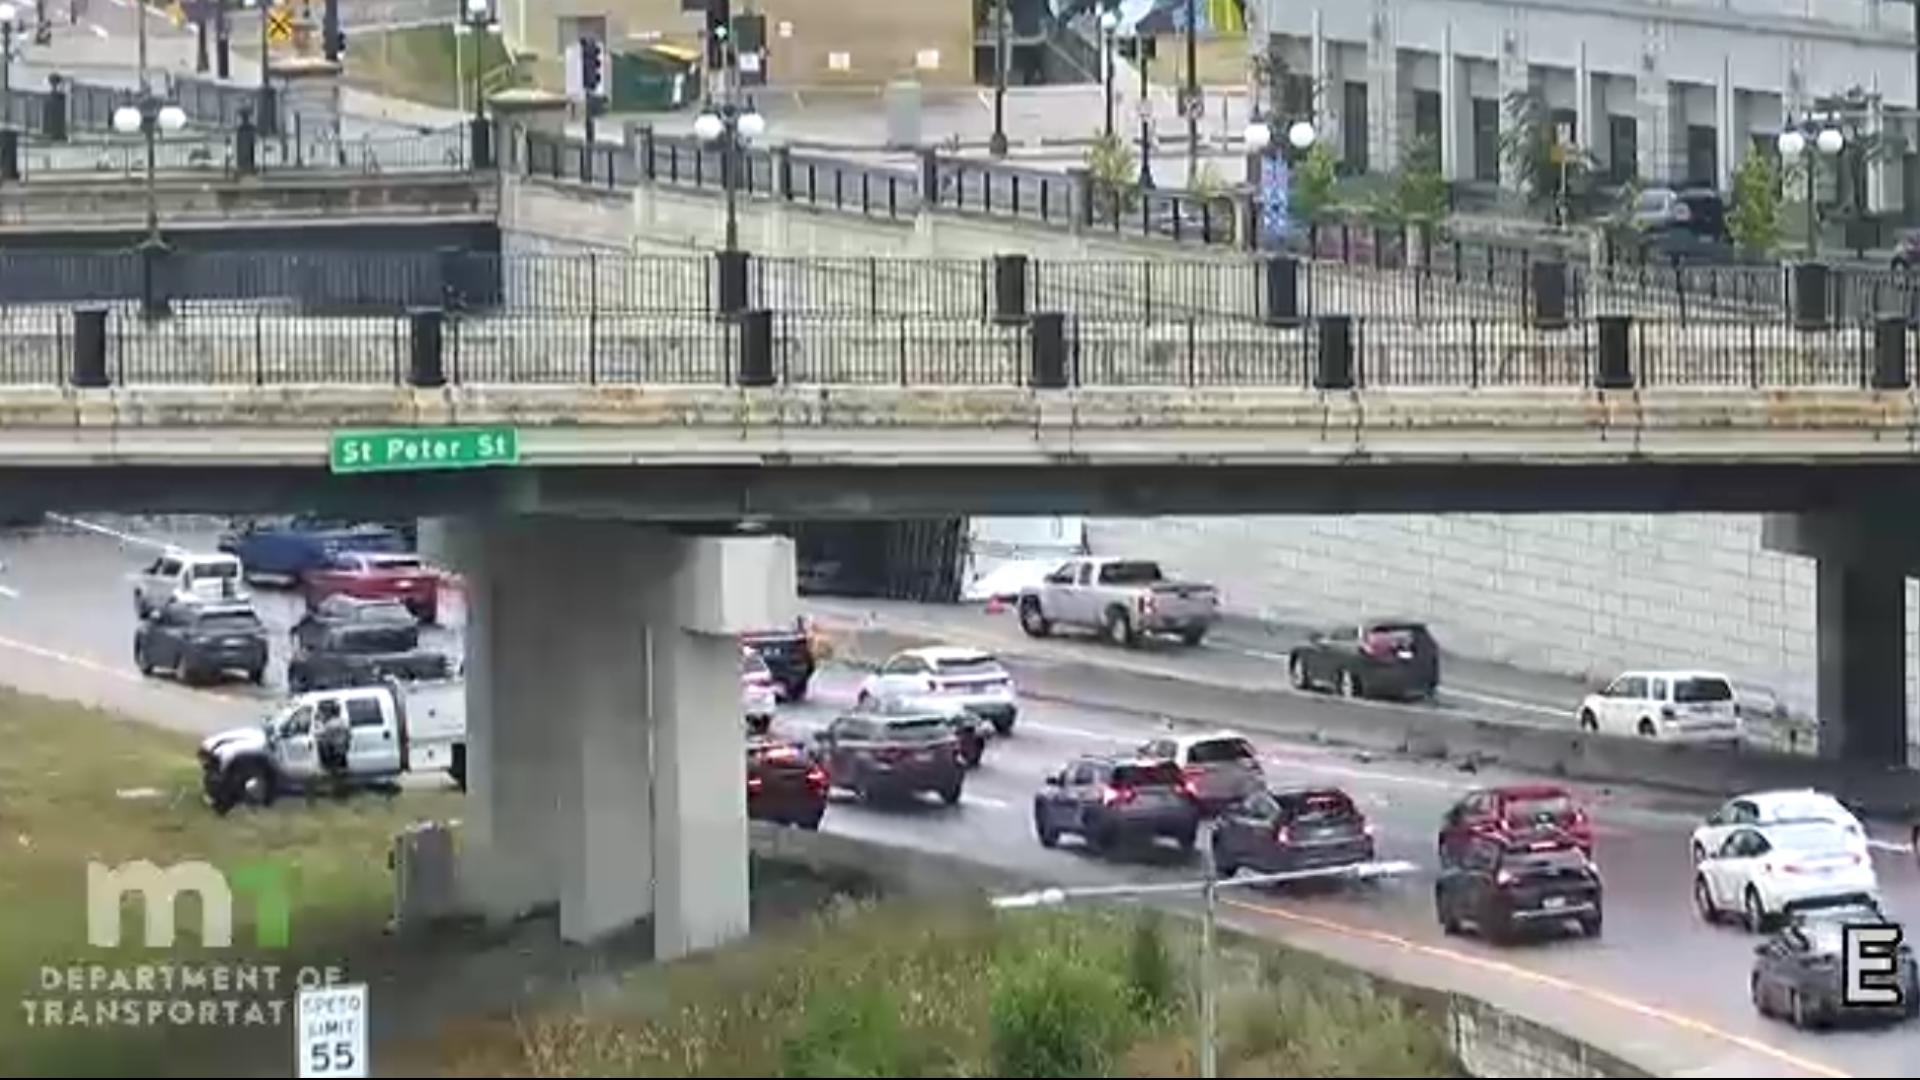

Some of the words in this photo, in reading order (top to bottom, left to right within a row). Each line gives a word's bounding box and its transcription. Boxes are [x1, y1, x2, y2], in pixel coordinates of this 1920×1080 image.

[342, 441, 372, 464] St
[387, 438, 461, 460] Peter
[477, 434, 506, 457] St
[308, 1019, 355, 1037] LIMIT
[311, 1042, 355, 1072] 55
